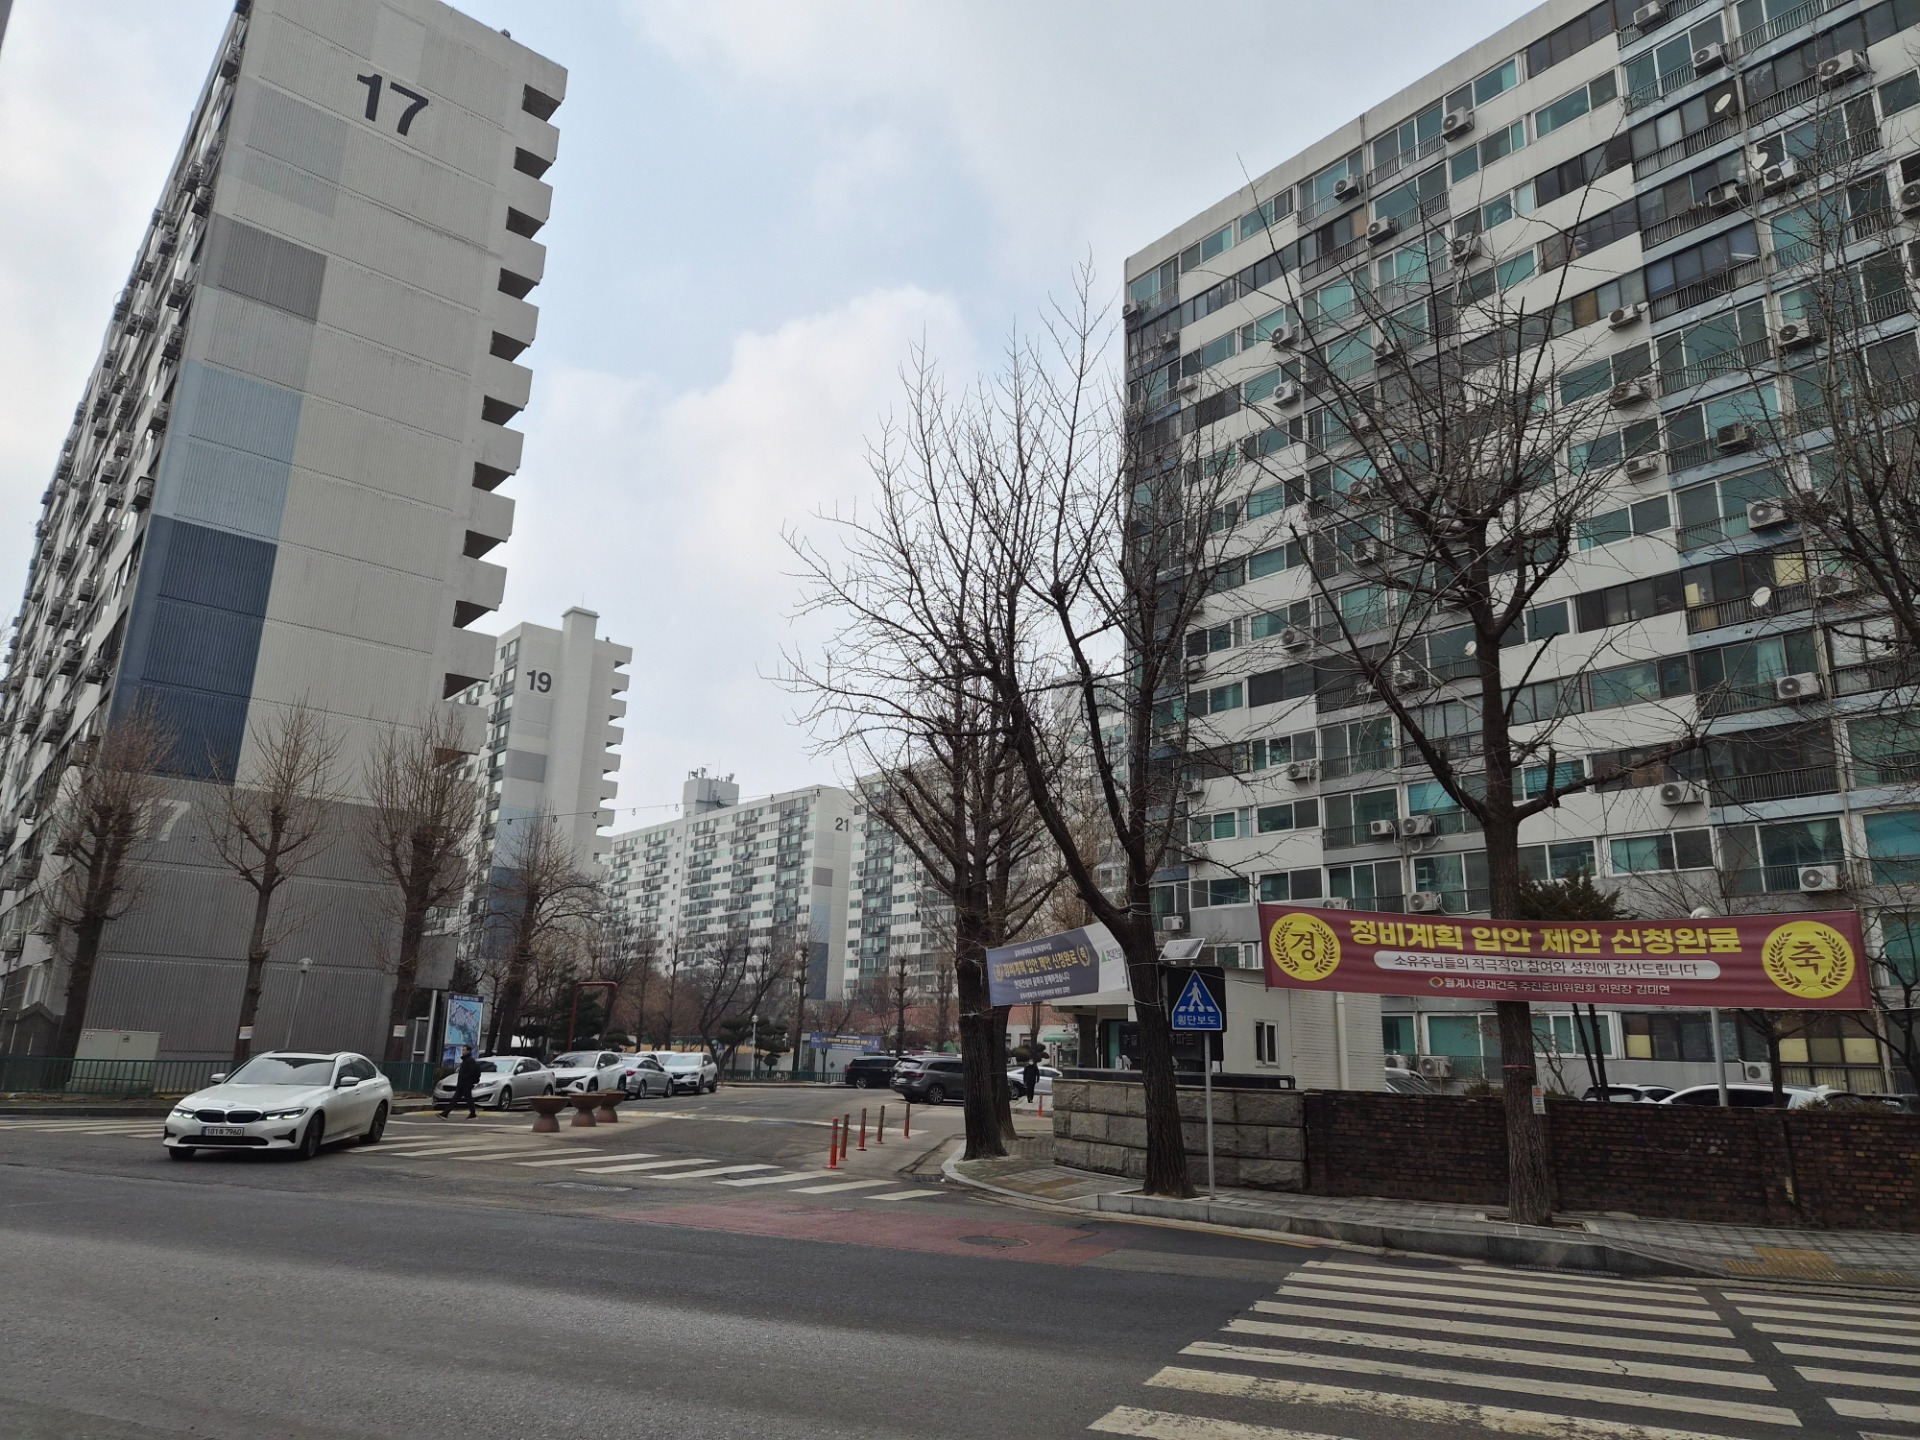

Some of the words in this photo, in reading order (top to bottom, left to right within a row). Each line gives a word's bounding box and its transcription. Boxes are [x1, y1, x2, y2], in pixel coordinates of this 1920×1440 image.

[356, 73, 429, 136] 17
[526, 669, 552, 693] 19
[834, 817, 850, 832] 21
[1290, 930, 1316, 961] 경
[1349, 919, 1463, 950] 정비계획
[1471, 927, 1532, 953] 입안
[1541, 928, 1602, 954] 제안
[1611, 927, 1743, 955] 신청완료
[1394, 954, 1469, 970] 소유주님들의
[1472, 956, 1525, 973] 적극적인
[1527, 958, 1567, 974] 참여와
[1570, 960, 1611, 975] 성원에
[1616, 961, 1698, 977] 감사드립니다
[1788, 941, 1826, 976] 축
[1599, 984, 1633, 994] 위원장
[1176, 1014, 1217, 1026] 횡단보도
